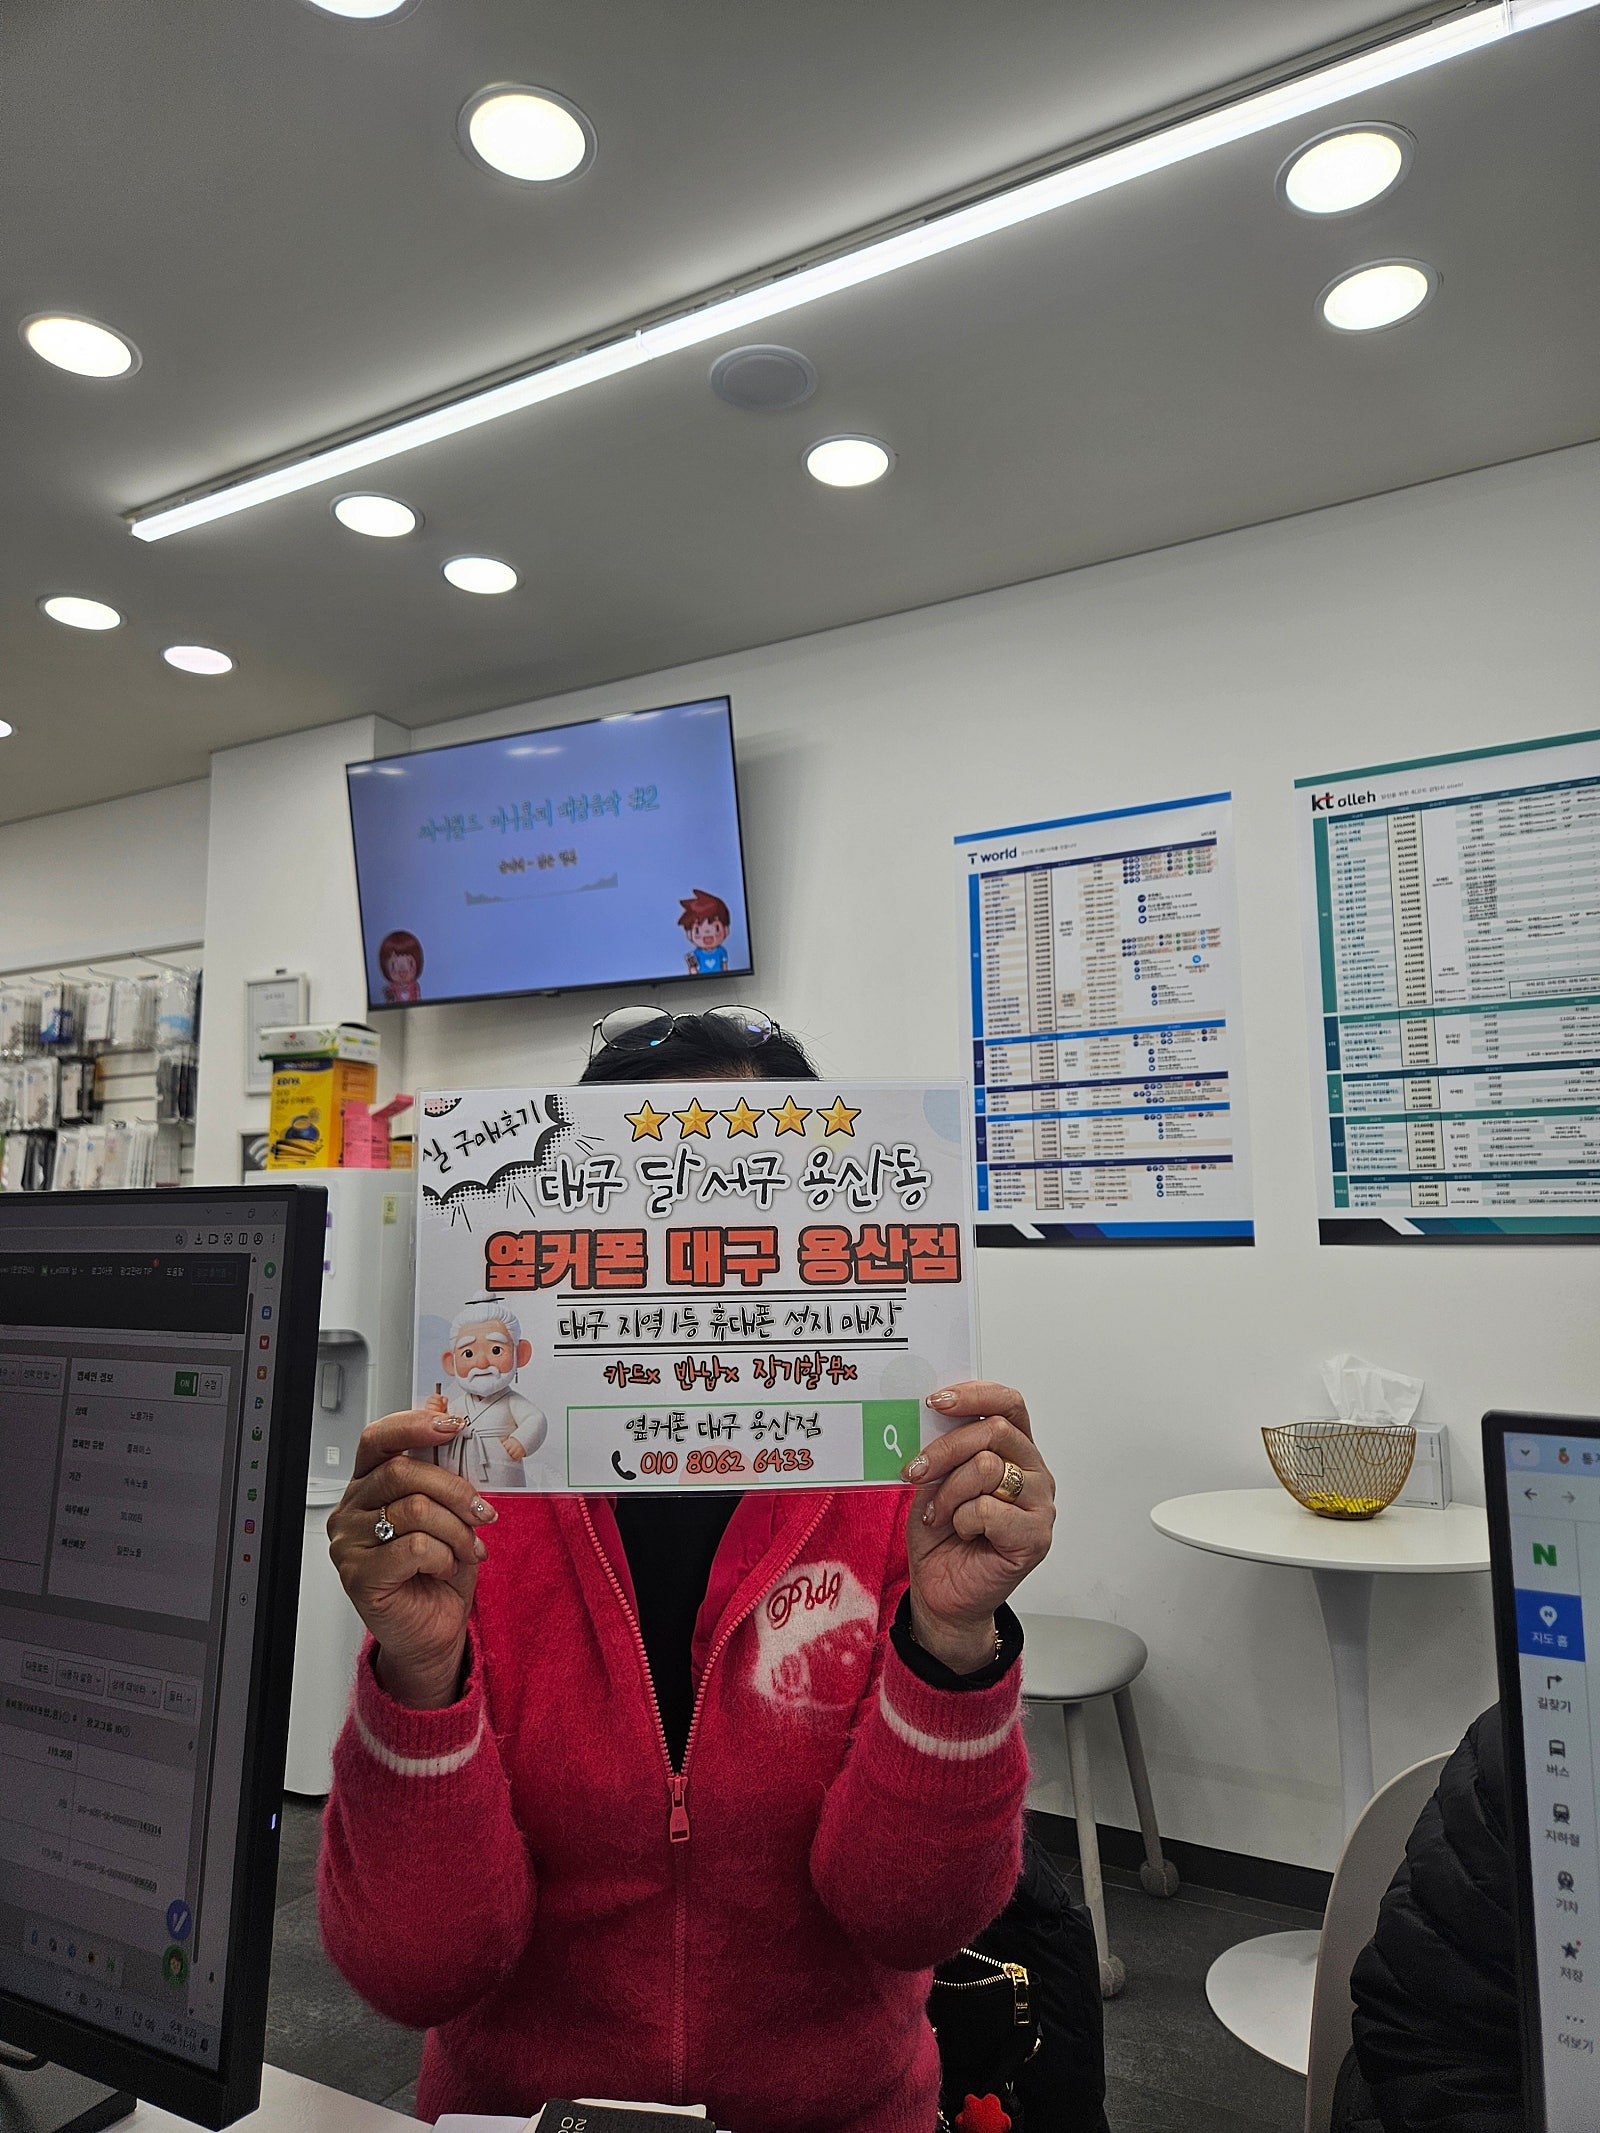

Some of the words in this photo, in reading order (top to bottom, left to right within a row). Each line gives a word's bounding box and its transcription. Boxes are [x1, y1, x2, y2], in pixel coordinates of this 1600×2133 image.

[629, 784, 660, 812] #2
[1311, 792, 1334, 811] kt
[1337, 790, 1376, 808] olleh
[967, 852, 978, 865] T
[980, 846, 1017, 863] world
[422, 1138, 452, 1174] 실
[453, 1100, 541, 1156] 구매후기
[539, 1157, 625, 1209] 대구
[640, 1147, 787, 1214] 달서구
[803, 1148, 928, 1208] 용산동
[485, 1229, 648, 1291] 옆커폰
[666, 1226, 780, 1288] 대구
[798, 1223, 961, 1285] 용산점
[559, 1310, 609, 1339] 대구
[619, 1308, 663, 1338] 지역
[673, 1307, 699, 1338] 1등
[710, 1302, 775, 1341] 휴대폰
[784, 1305, 832, 1336] 성지
[841, 1301, 903, 1337] 매장
[99, 1372, 114, 1383] 정보
[179, 1379, 190, 1388] ON
[203, 1379, 217, 1390] 수정
[74, 1406, 88, 1416] 상태
[626, 1411, 689, 1442] 옆커폰
[697, 1413, 741, 1440] 대구
[750, 1411, 822, 1441] 용산점
[640, 1451, 678, 1475] 010
[686, 1450, 745, 1474] 8062
[753, 1448, 814, 1473] 6433
[1532, 1542, 1557, 1566] N
[1531, 1631, 1554, 1645] 지도
[1556, 1635, 1568, 1648] 홈
[1537, 1696, 1572, 1713] 길찾기
[1546, 1763, 1570, 1777] 버스
[1545, 1829, 1580, 1847] 지하철
[1556, 1898, 1579, 1915] 기차
[1560, 1966, 1584, 1983] 저장
[1558, 2033, 1594, 2054] 더보기
